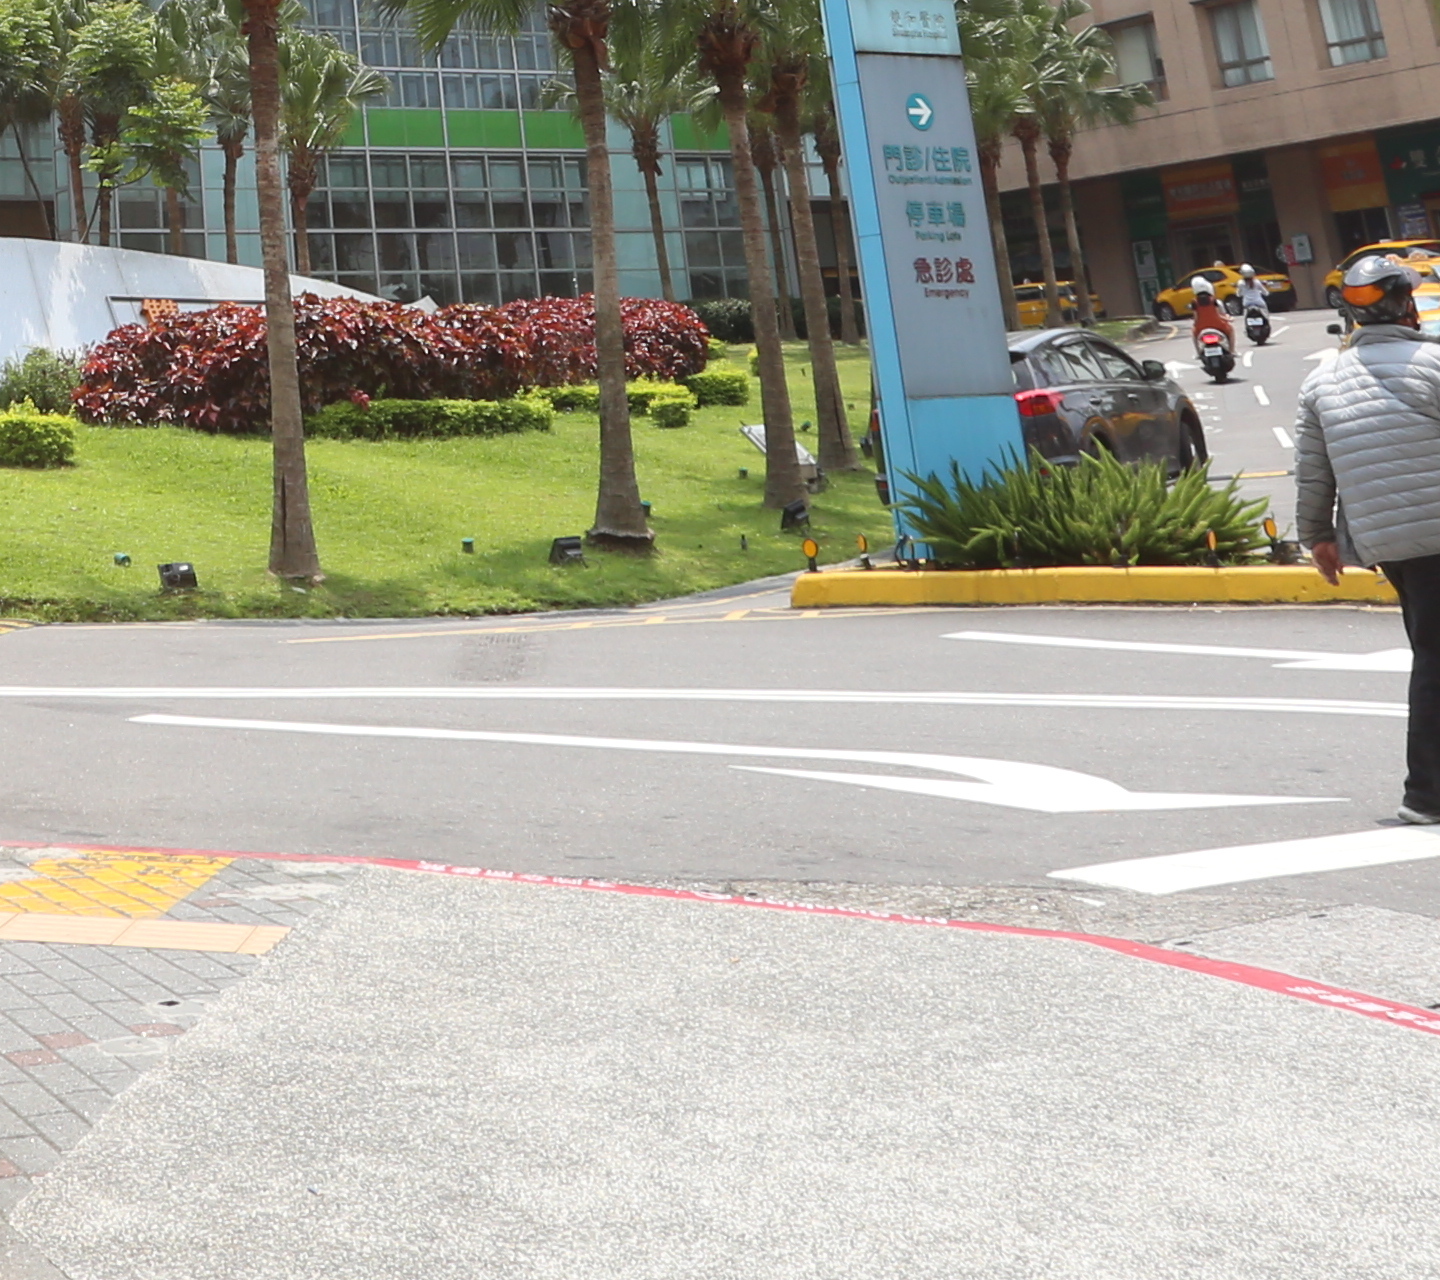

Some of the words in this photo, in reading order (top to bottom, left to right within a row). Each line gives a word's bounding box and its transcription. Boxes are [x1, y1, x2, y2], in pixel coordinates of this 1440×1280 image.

[883, 145, 973, 173] 門診/住院
[906, 200, 965, 227] 停車場
[913, 256, 976, 284] 急診處
